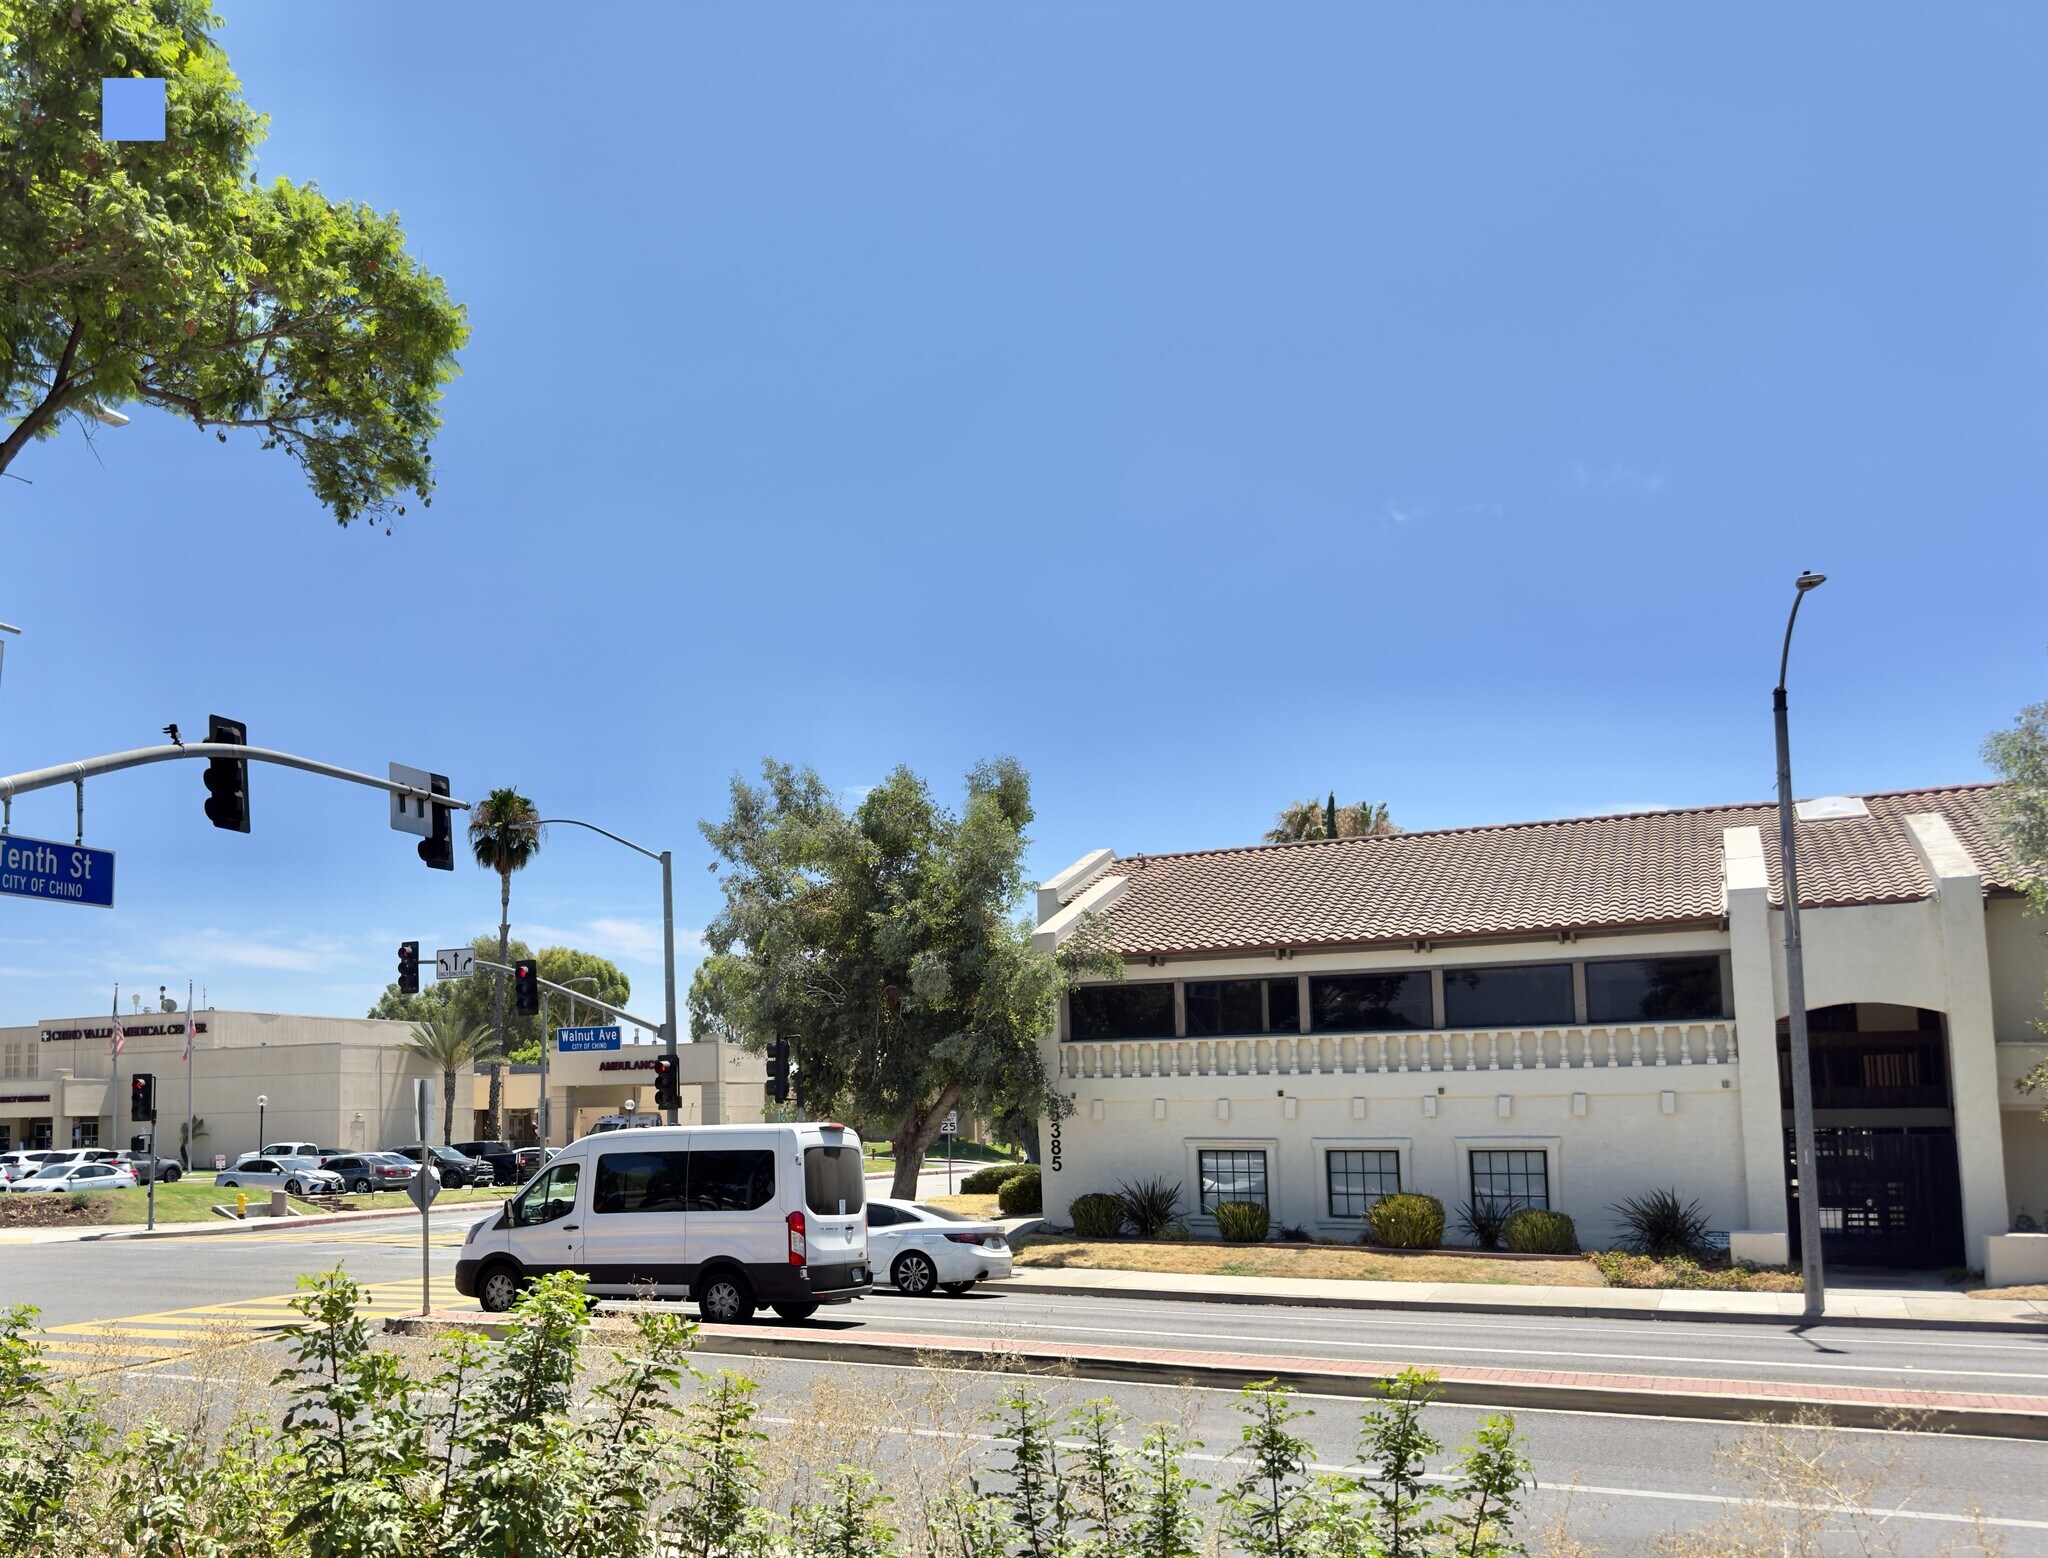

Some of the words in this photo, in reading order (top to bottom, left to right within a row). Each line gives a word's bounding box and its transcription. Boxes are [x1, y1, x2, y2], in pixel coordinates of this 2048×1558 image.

[0, 841, 58, 875] Tenth
[70, 852, 92, 880] St
[2, 874, 27, 890] CITY
[31, 878, 46, 893] OF
[49, 880, 83, 898] CHINO
[52, 1030, 82, 1041] CHINO
[83, 1028, 113, 1039] VALLE
[122, 1025, 167, 1037] MEDICAL
[167, 1023, 208, 1035] CENER
[561, 1029, 595, 1042] Walnut
[599, 1028, 617, 1041] Ave
[591, 1042, 608, 1050] CHINO
[599, 1060, 657, 1071] AMBULANC
[942, 1122, 956, 1131] 25
